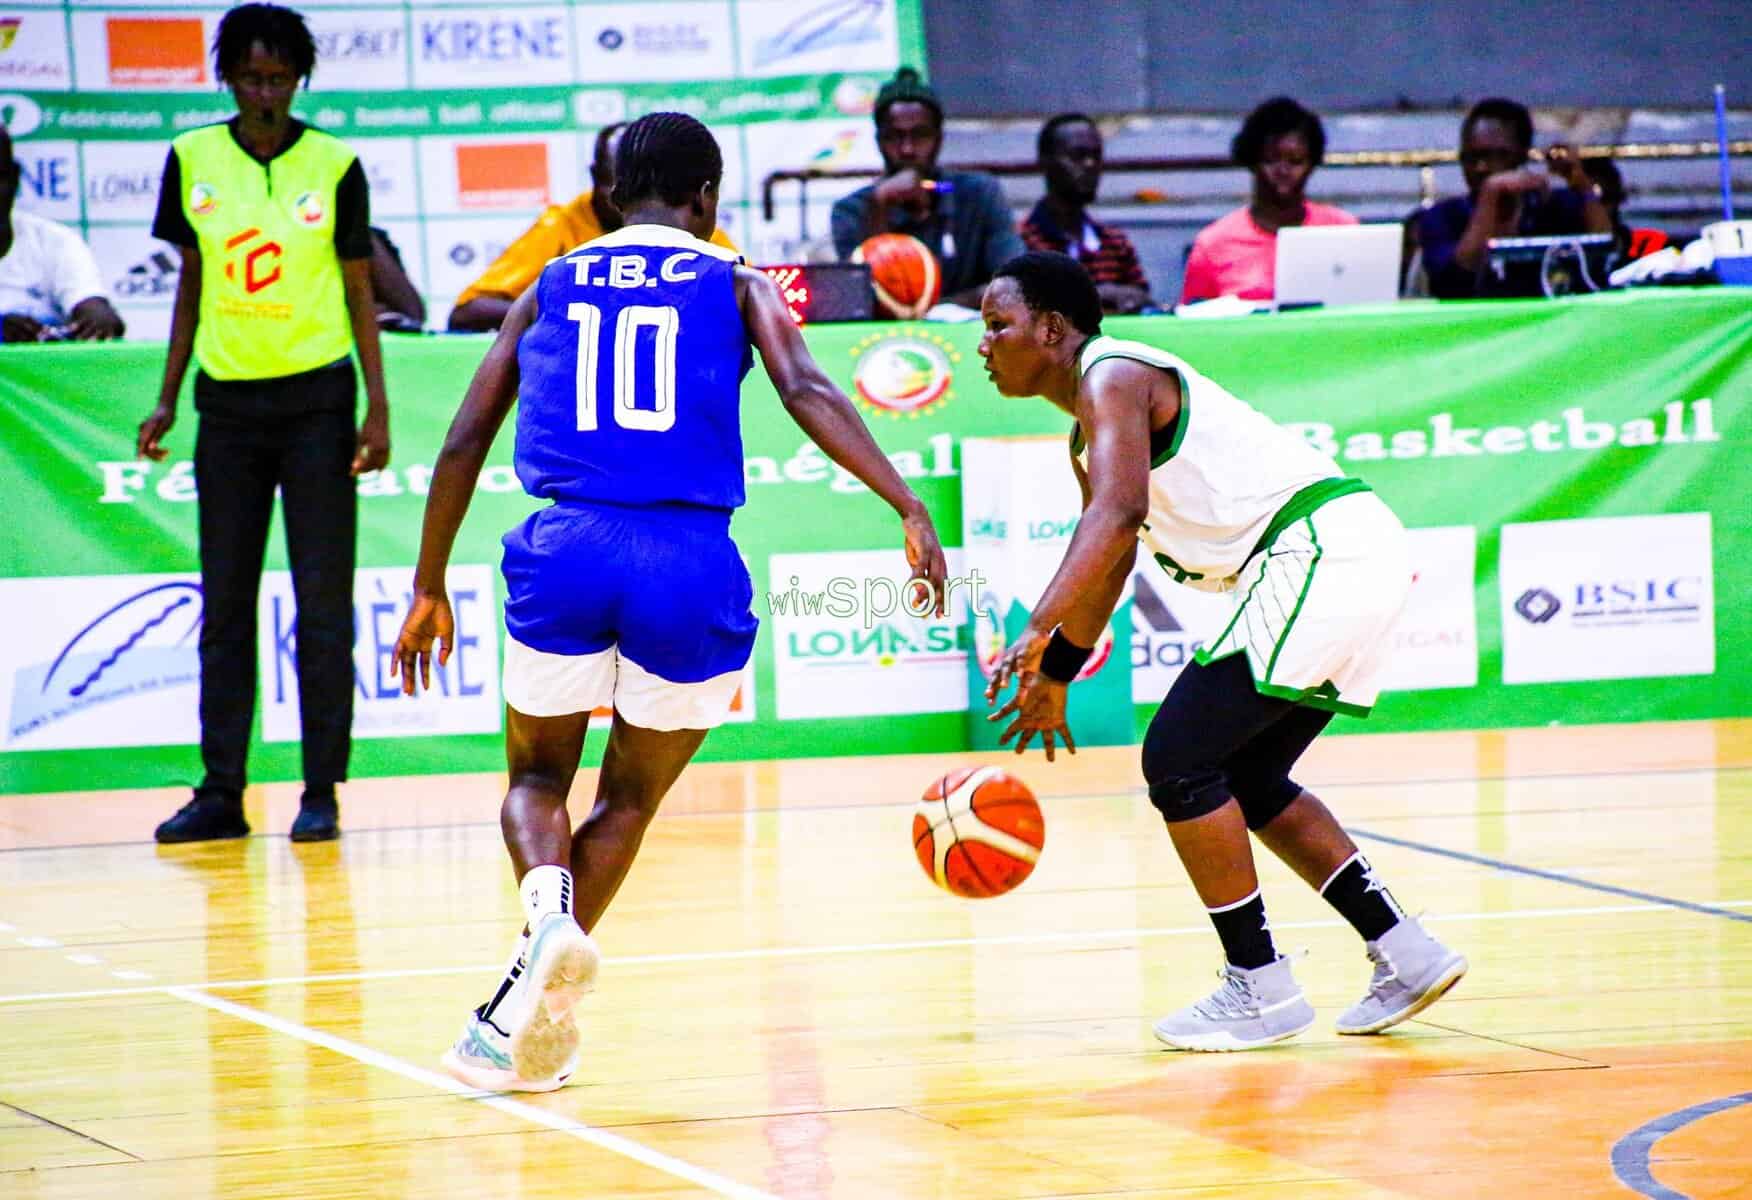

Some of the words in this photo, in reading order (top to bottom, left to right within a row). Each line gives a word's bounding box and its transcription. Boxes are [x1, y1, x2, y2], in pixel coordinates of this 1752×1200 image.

[566, 252, 699, 289] T.B.C
[567, 302, 679, 432] 10
[1284, 401, 1721, 461] Basketball
[1574, 577, 1702, 606] BSIC
